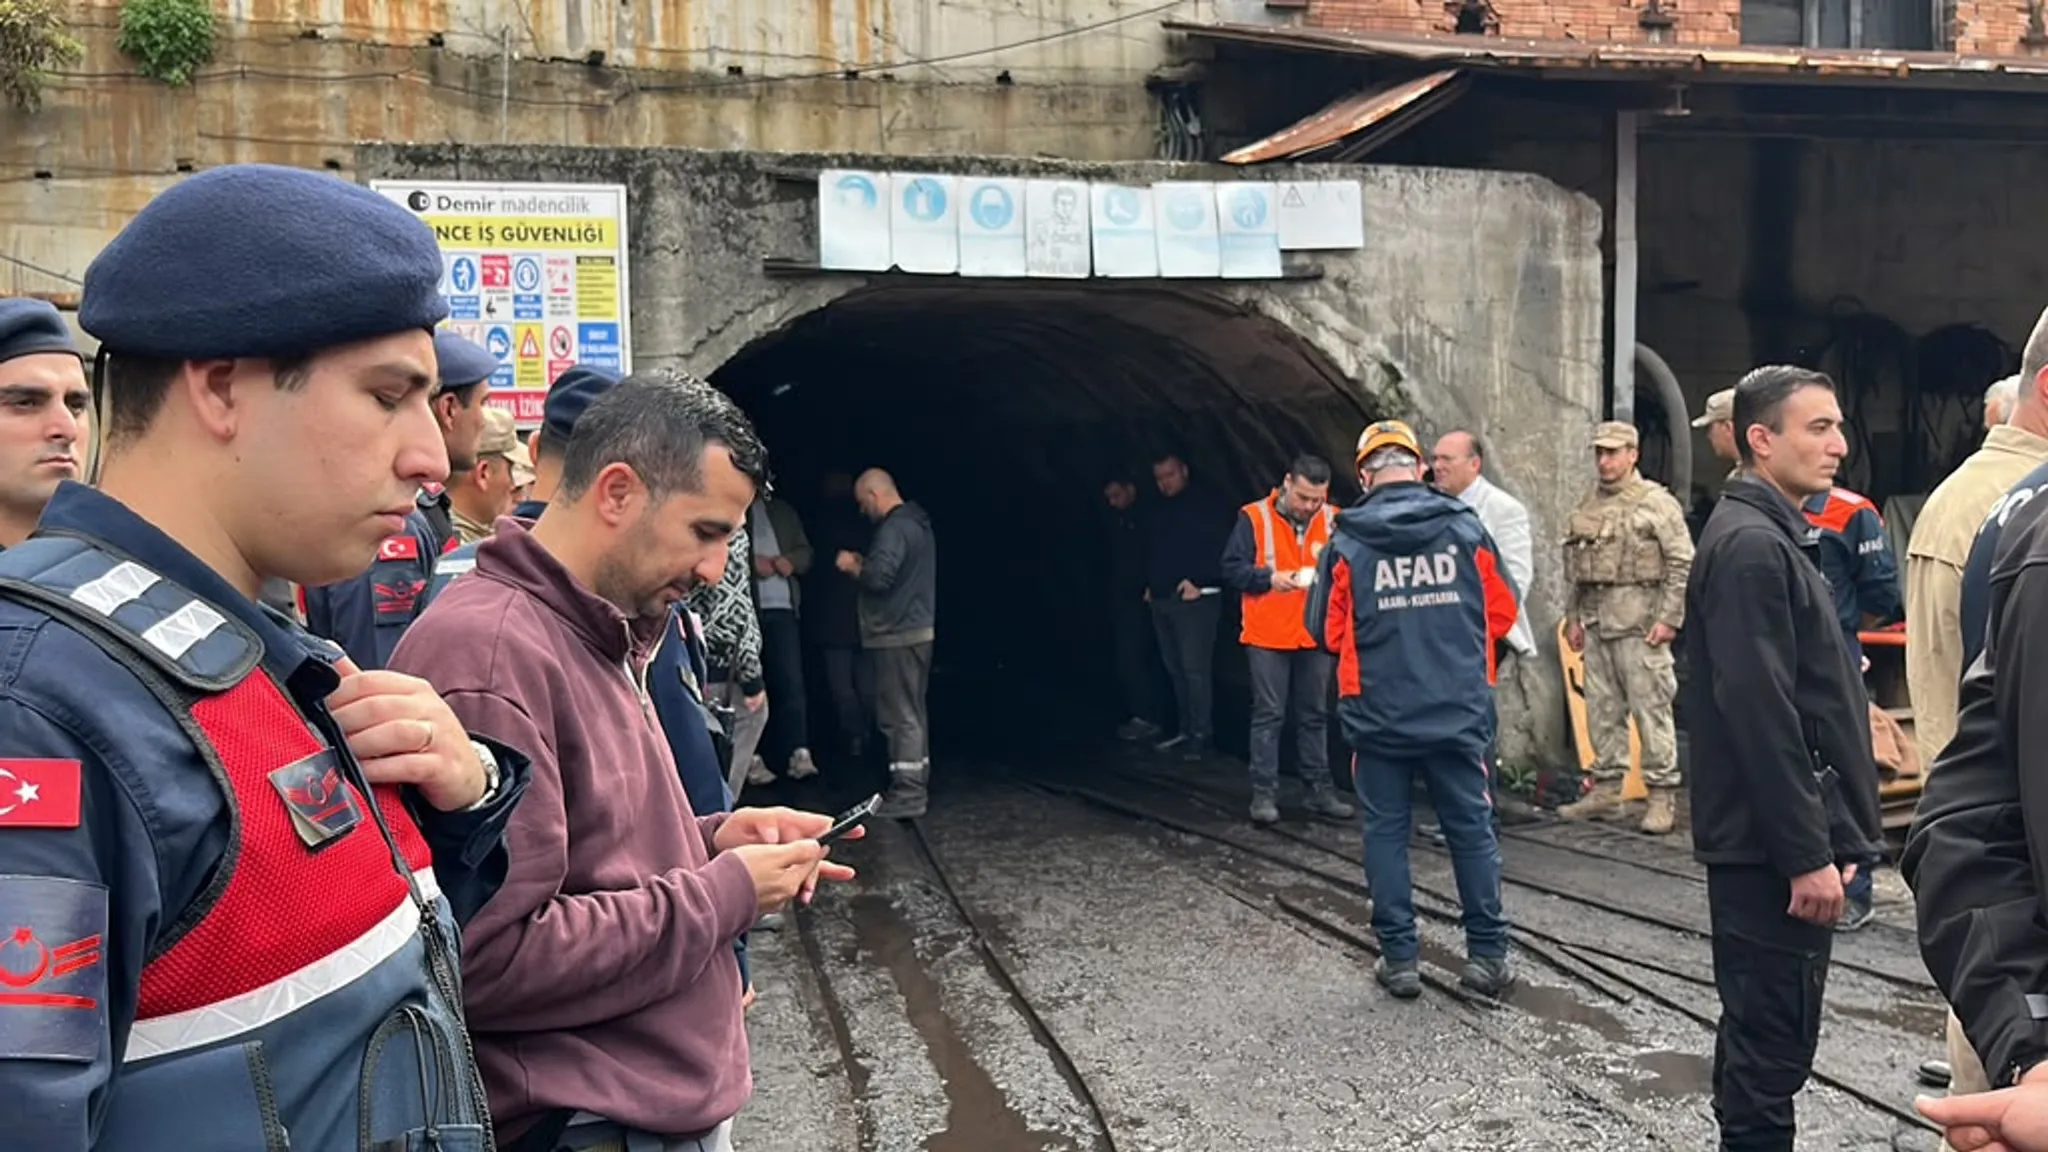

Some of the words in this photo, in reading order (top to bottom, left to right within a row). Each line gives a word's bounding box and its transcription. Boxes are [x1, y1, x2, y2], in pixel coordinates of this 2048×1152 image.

[437, 196, 496, 212] Demir
[501, 196, 590, 214] madencilik
[430, 223, 472, 241] NCE
[479, 221, 495, 246] İŞ
[501, 222, 604, 243] GÜVENLİĞİ
[1374, 552, 1457, 592] AFAD
